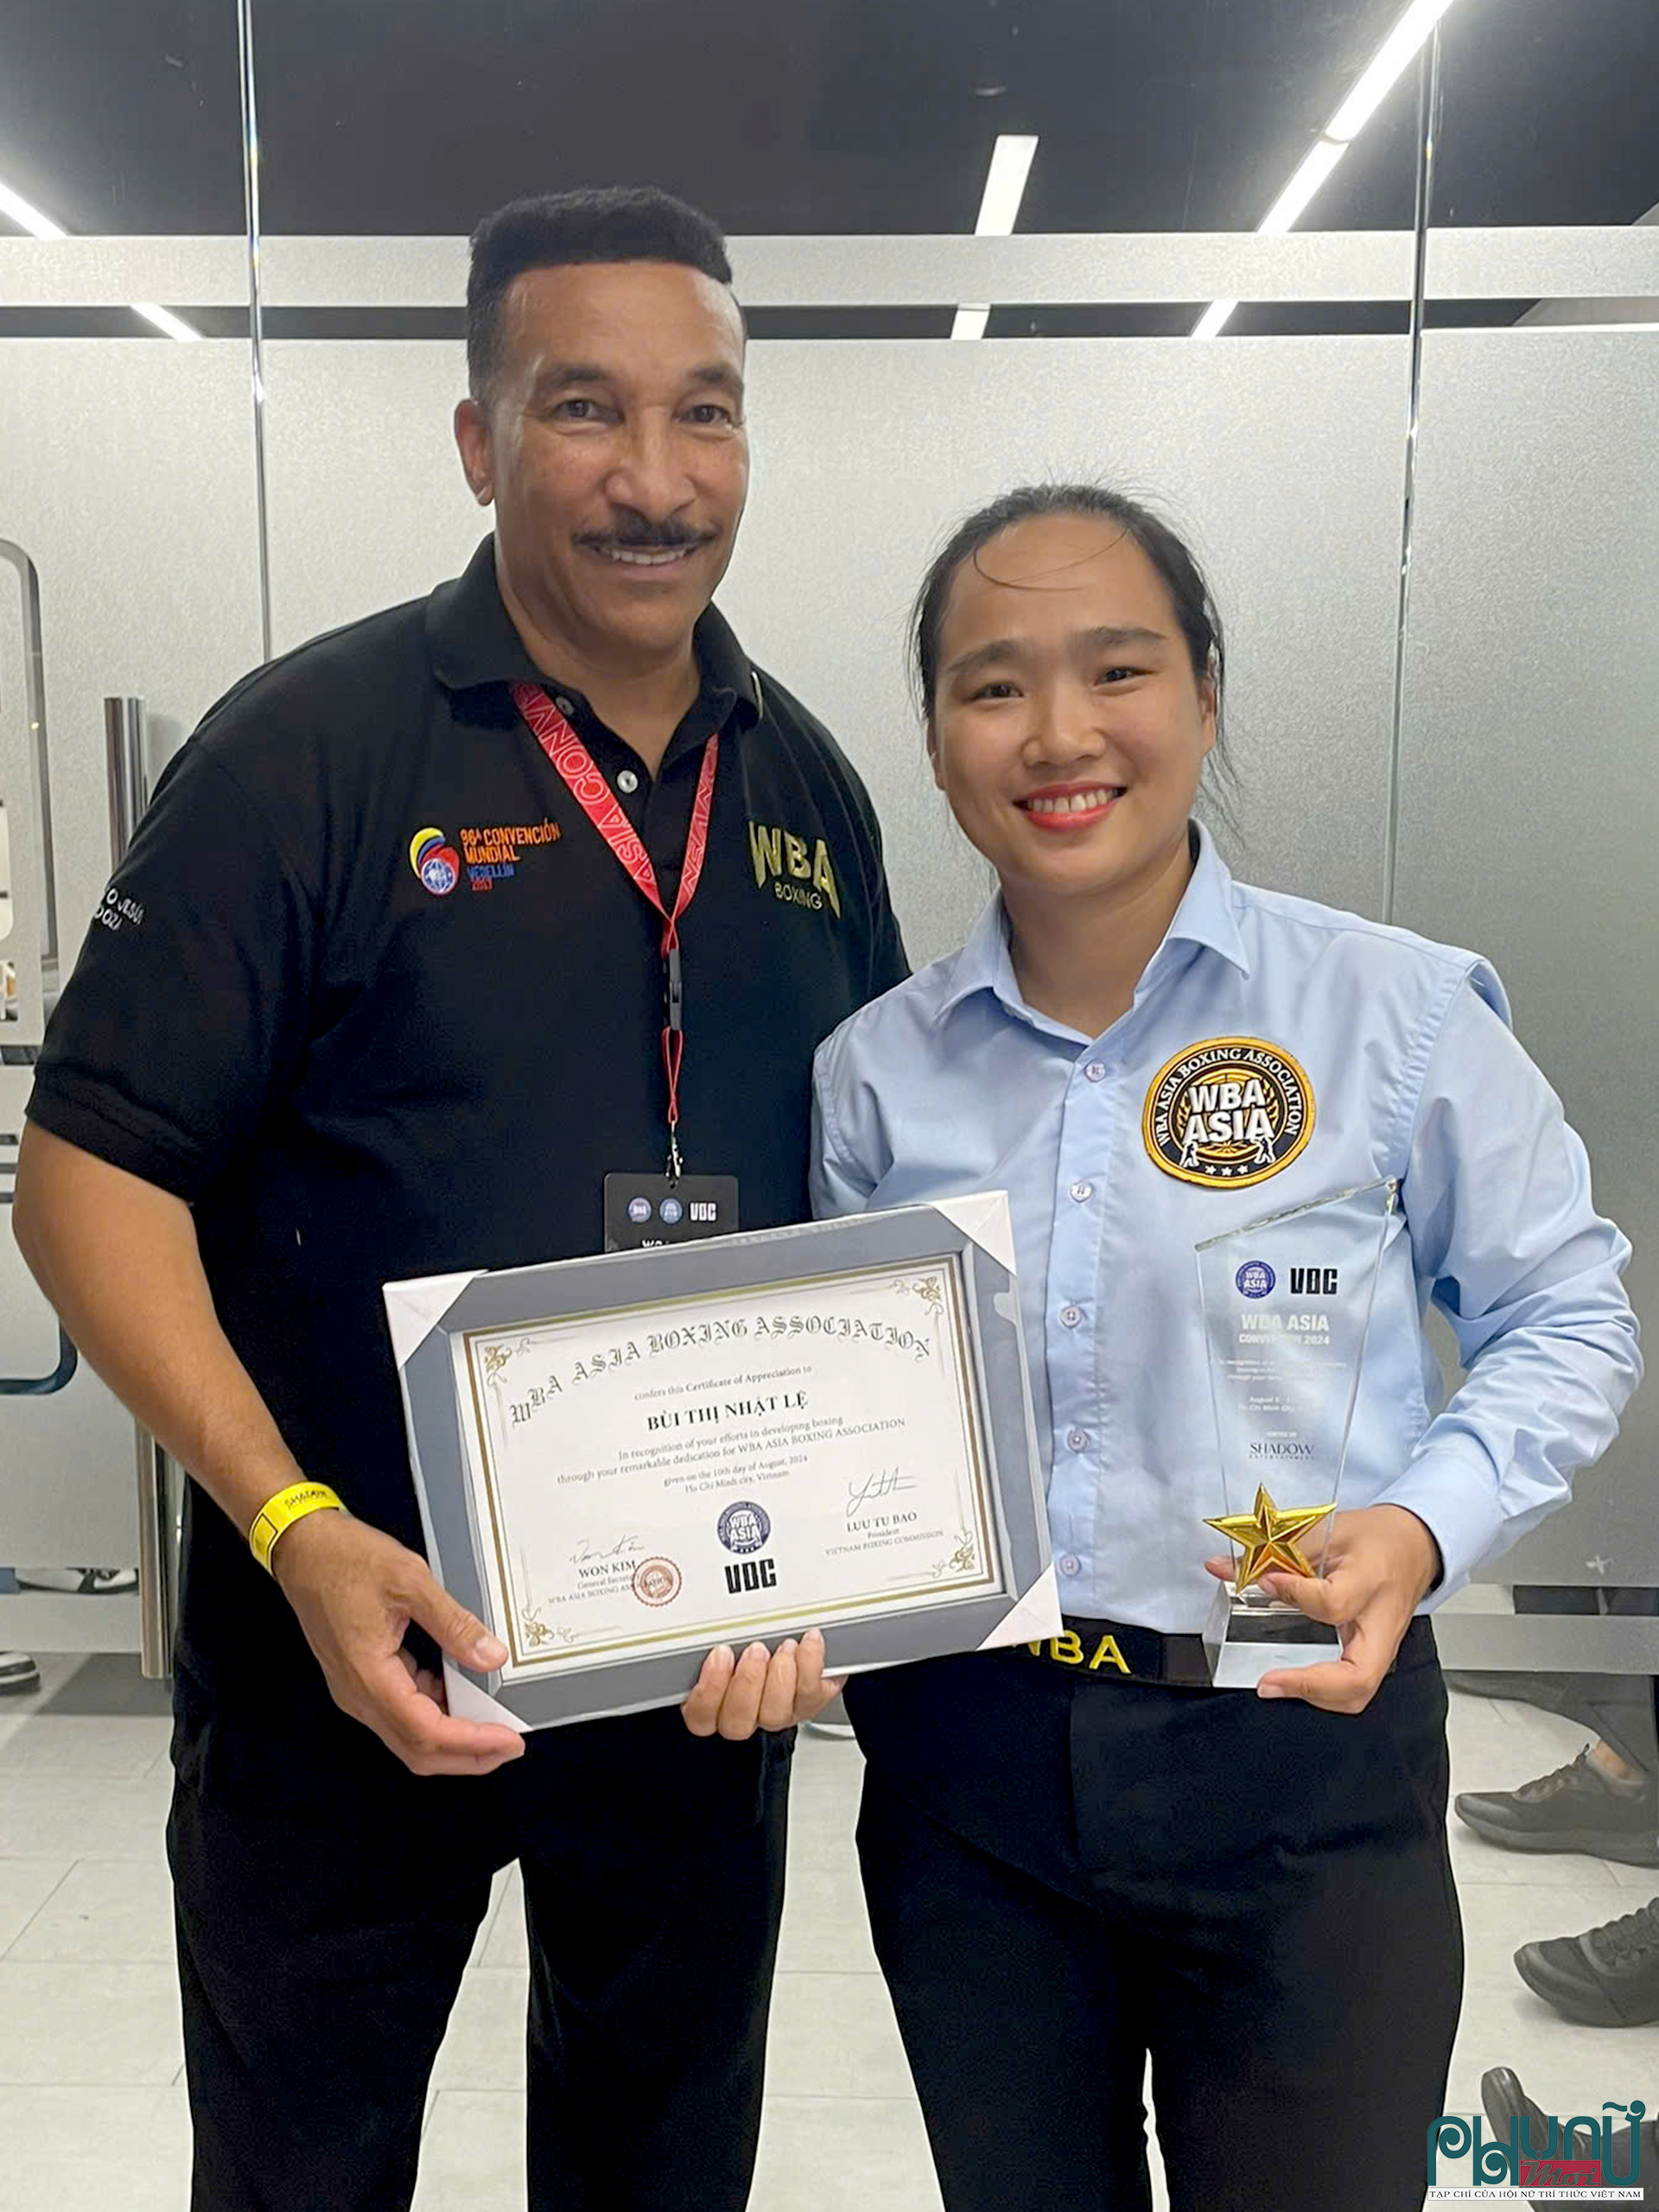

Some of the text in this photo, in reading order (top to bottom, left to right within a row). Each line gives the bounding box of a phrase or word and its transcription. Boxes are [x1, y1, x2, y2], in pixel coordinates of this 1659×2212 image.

[748, 821, 840, 918] WBA
[1160, 1076, 1184, 1109] ASIA
[1180, 1048, 1243, 1078] BOXING
[1243, 1049, 1302, 1135] ASSOCIATION
[1188, 1078, 1266, 1113] WBA
[1183, 1108, 1274, 1145] ASIA
[1287, 1314, 1329, 1331] ASIA
[571, 1341, 641, 1386] ASIA
[647, 1318, 747, 1358] BOXING
[753, 1315, 930, 1361] ASSOCIATION
[685, 1376, 732, 1393] Certificate
[733, 1375, 744, 1385] of
[745, 1365, 801, 1385] Appreciation
[803, 1364, 812, 1374] to
[684, 1406, 719, 1424] THỊ
[784, 1390, 809, 1410] LỆ
[557, 1417, 906, 1485] through your remarkable dedication for WBA ASIA BOXING ASSOCIATION
[630, 1442, 683, 1459] recognition
[685, 1438, 696, 1450] of
[696, 1436, 717, 1451] your
[719, 1428, 748, 1444] efforts
[750, 1427, 760, 1439] in
[761, 1420, 810, 1439] developing
[812, 1415, 843, 1428] boxing
[1249, 1443, 1314, 1454] SHADOW
[730, 1525, 761, 1541] ASIA
[578, 1560, 636, 1579] WON KIM
